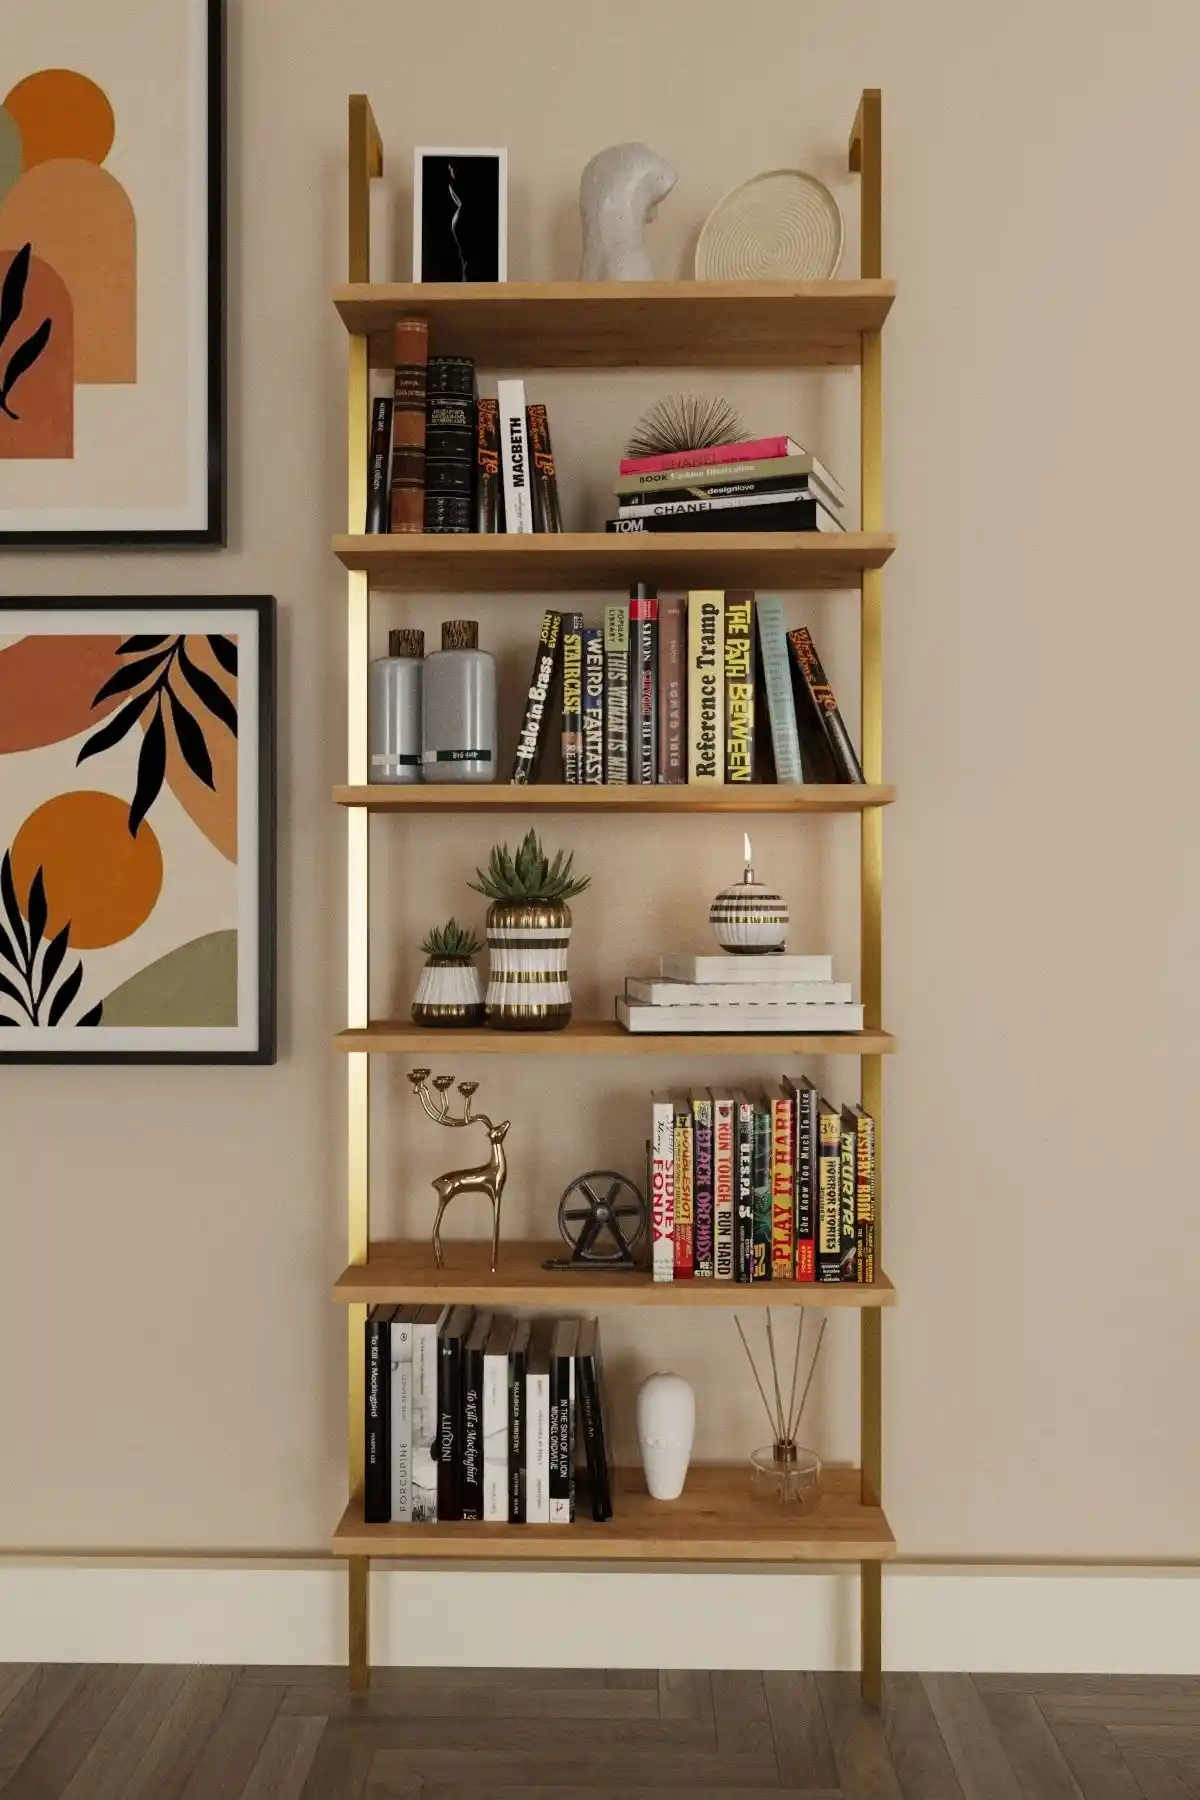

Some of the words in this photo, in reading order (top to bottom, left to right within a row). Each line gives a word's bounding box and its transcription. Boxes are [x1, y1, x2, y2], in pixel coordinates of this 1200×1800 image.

[510, 418, 524, 487] MACBETH
[640, 474, 668, 483] BOOK
[614, 519, 643, 532] TOM
[540, 614, 552, 643] JOHN
[548, 616, 561, 649] EVANS
[725, 600, 751, 634] THE
[697, 604, 719, 669] Tramp
[563, 634, 581, 714] STAIRCASE
[586, 638, 602, 696] WEIRD
[607, 652, 628, 681] THIS
[725, 638, 751, 679] PATH
[528, 656, 553, 701] Brass
[642, 669, 652, 715] PIRATES
[526, 704, 544, 720] in
[607, 687, 628, 733] WOMAN
[670, 682, 679, 729] GANGS
[516, 722, 542, 759] Halo
[696, 675, 717, 777] Reference
[727, 683, 753, 781] BETWEEN
[584, 708, 602, 784] FANTASY
[607, 738, 628, 751] IS
[670, 737, 679, 767] GIRL
[566, 744, 576, 784] REILLY
[800, 1092, 809, 1115] Live
[718, 1123, 730, 1150] RUN
[775, 1100, 792, 1165] HARD
[800, 1119, 809, 1129] To
[696, 1130, 712, 1186] BLACK
[800, 1135, 809, 1159] Much
[857, 1118, 871, 1178] MYSTERY
[682, 1130, 691, 1223] DOUBLESHOT
[716, 1158, 730, 1206] TOUGH,
[774, 1174, 792, 1197] IT
[800, 1165, 809, 1182] Too
[826, 1160, 836, 1205] HORROR
[841, 1132, 854, 1238] MEURTRE
[653, 1159, 664, 1243] FONDA
[666, 1160, 674, 1243] SIDNEY
[800, 1186, 809, 1211] Know
[857, 1184, 871, 1222] BOOK
[696, 1192, 712, 1262] ORCHIDS
[718, 1212, 731, 1236] RUN
[774, 1204, 792, 1261] PLAY
[800, 1217, 809, 1233] She
[826, 1208, 836, 1250] STORIES
[718, 1242, 731, 1275] HARD
[371, 1335, 379, 1345] To
[371, 1347, 379, 1358] Kill
[370, 1367, 379, 1417] Mockingbird
[466, 1390, 476, 1402] To
[560, 1399, 568, 1408] IN
[466, 1403, 476, 1420] Kill
[550, 1406, 558, 1435] MICHAEL
[560, 1409, 568, 1423] THE
[442, 1413, 454, 1462] INIQUITY
[560, 1424, 568, 1441] SKIN
[560, 1442, 568, 1452] OF
[463, 1429, 477, 1486] Mockingbird
[550, 1436, 558, 1470] ONDAATJE
[559, 1460, 568, 1478] LION
